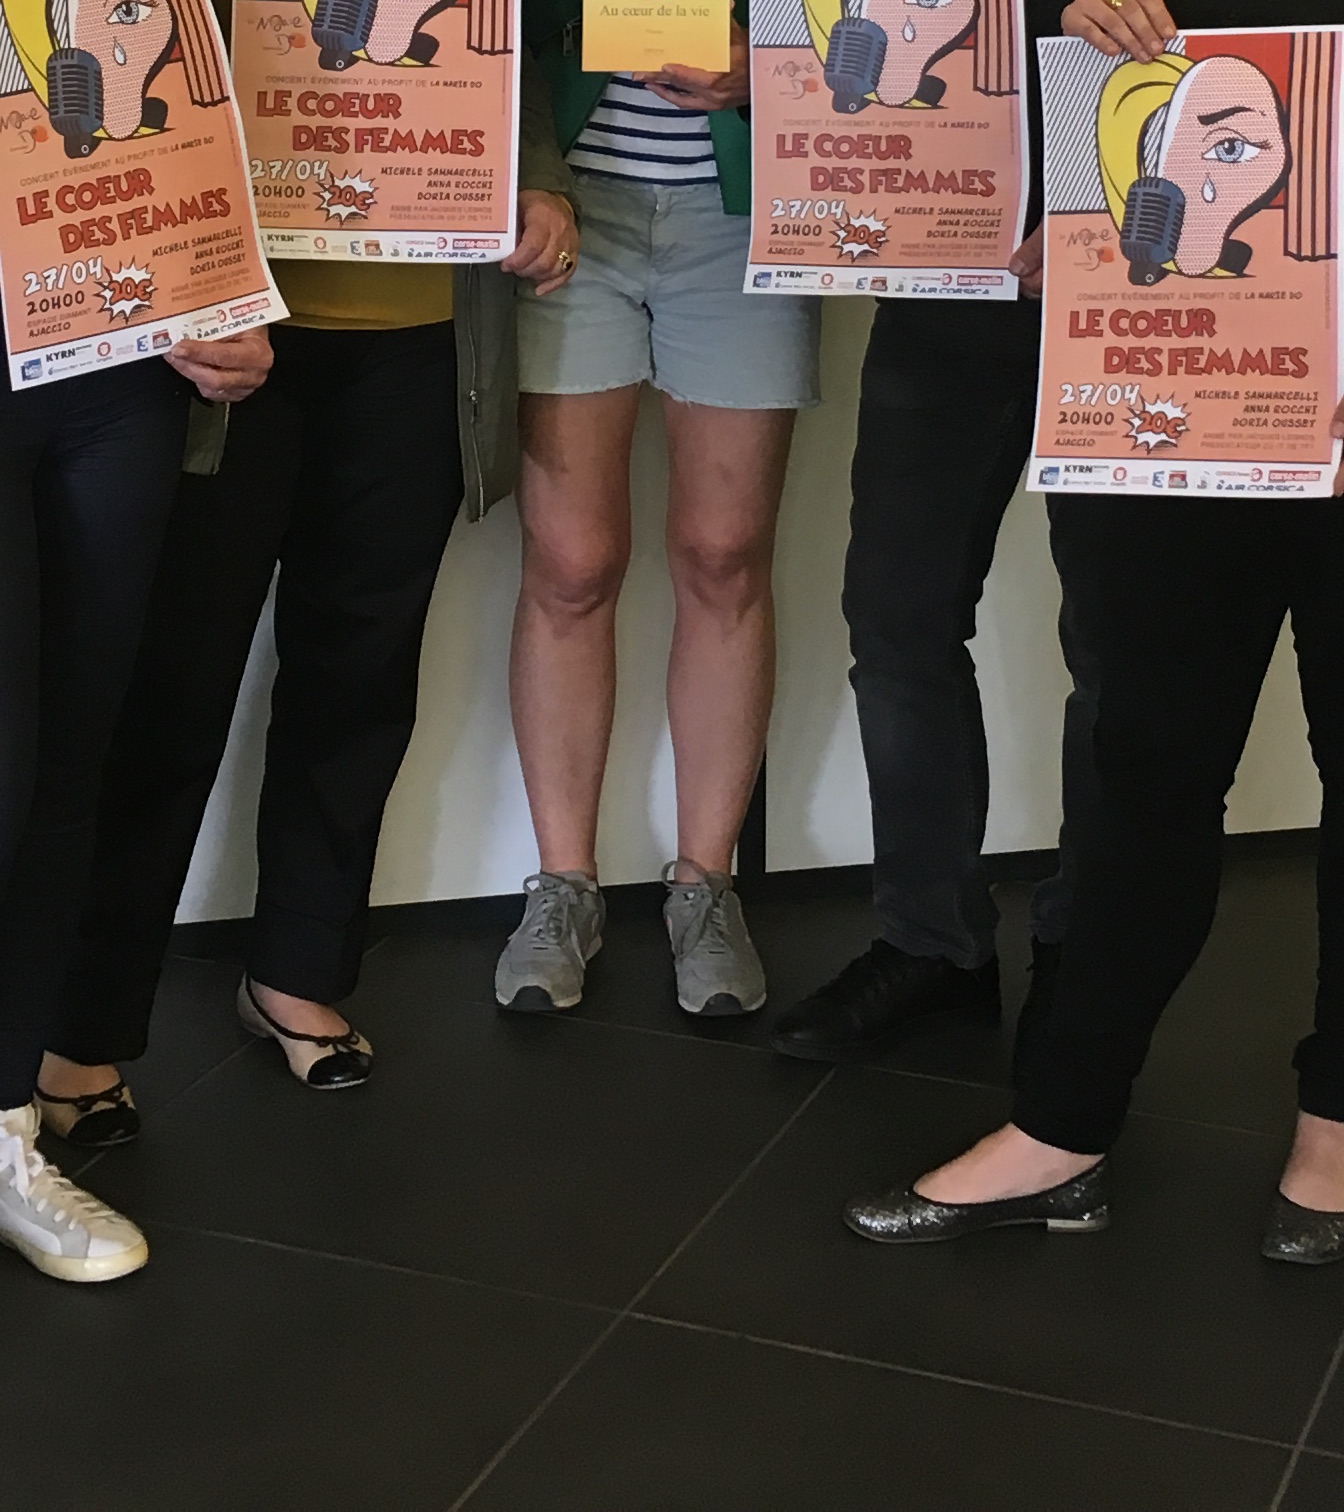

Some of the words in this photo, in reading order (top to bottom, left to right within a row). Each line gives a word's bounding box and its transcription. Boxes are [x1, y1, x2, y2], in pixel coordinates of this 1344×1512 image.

[600, 5, 618, 16] Au
[657, 6, 672, 16] de
[676, 5, 686, 16] la
[691, 6, 709, 16] vie
[256, 90, 292, 117] LE
[297, 91, 402, 120] COEUR
[292, 125, 350, 154] DES
[354, 127, 485, 157] FEMMES
[776, 133, 809, 159] LE
[813, 133, 912, 161] COEUR
[250, 159, 329, 181] 27/04
[809, 167, 865, 194] DES
[869, 168, 996, 197] FEMMES
[16, 189, 53, 226] LE
[55, 167, 155, 214] COEUR
[327, 185, 374, 211] 20€
[770, 198, 846, 220] 27/04
[58, 219, 117, 254] DES
[117, 188, 231, 241] FEMMES
[770, 223, 822, 236] 20H00
[842, 224, 886, 248] 20€
[22, 255, 103, 296] 27/04
[109, 278, 153, 302] 20€
[26, 291, 85, 316] 20H00
[1068, 309, 1104, 338] LE
[1109, 308, 1217, 339] COEUR
[1104, 346, 1163, 377] DES
[1167, 347, 1309, 378] FEMMES
[1058, 383, 1141, 406] 27/04
[1058, 411, 1114, 425] 20H00
[1139, 411, 1185, 438] 20€
